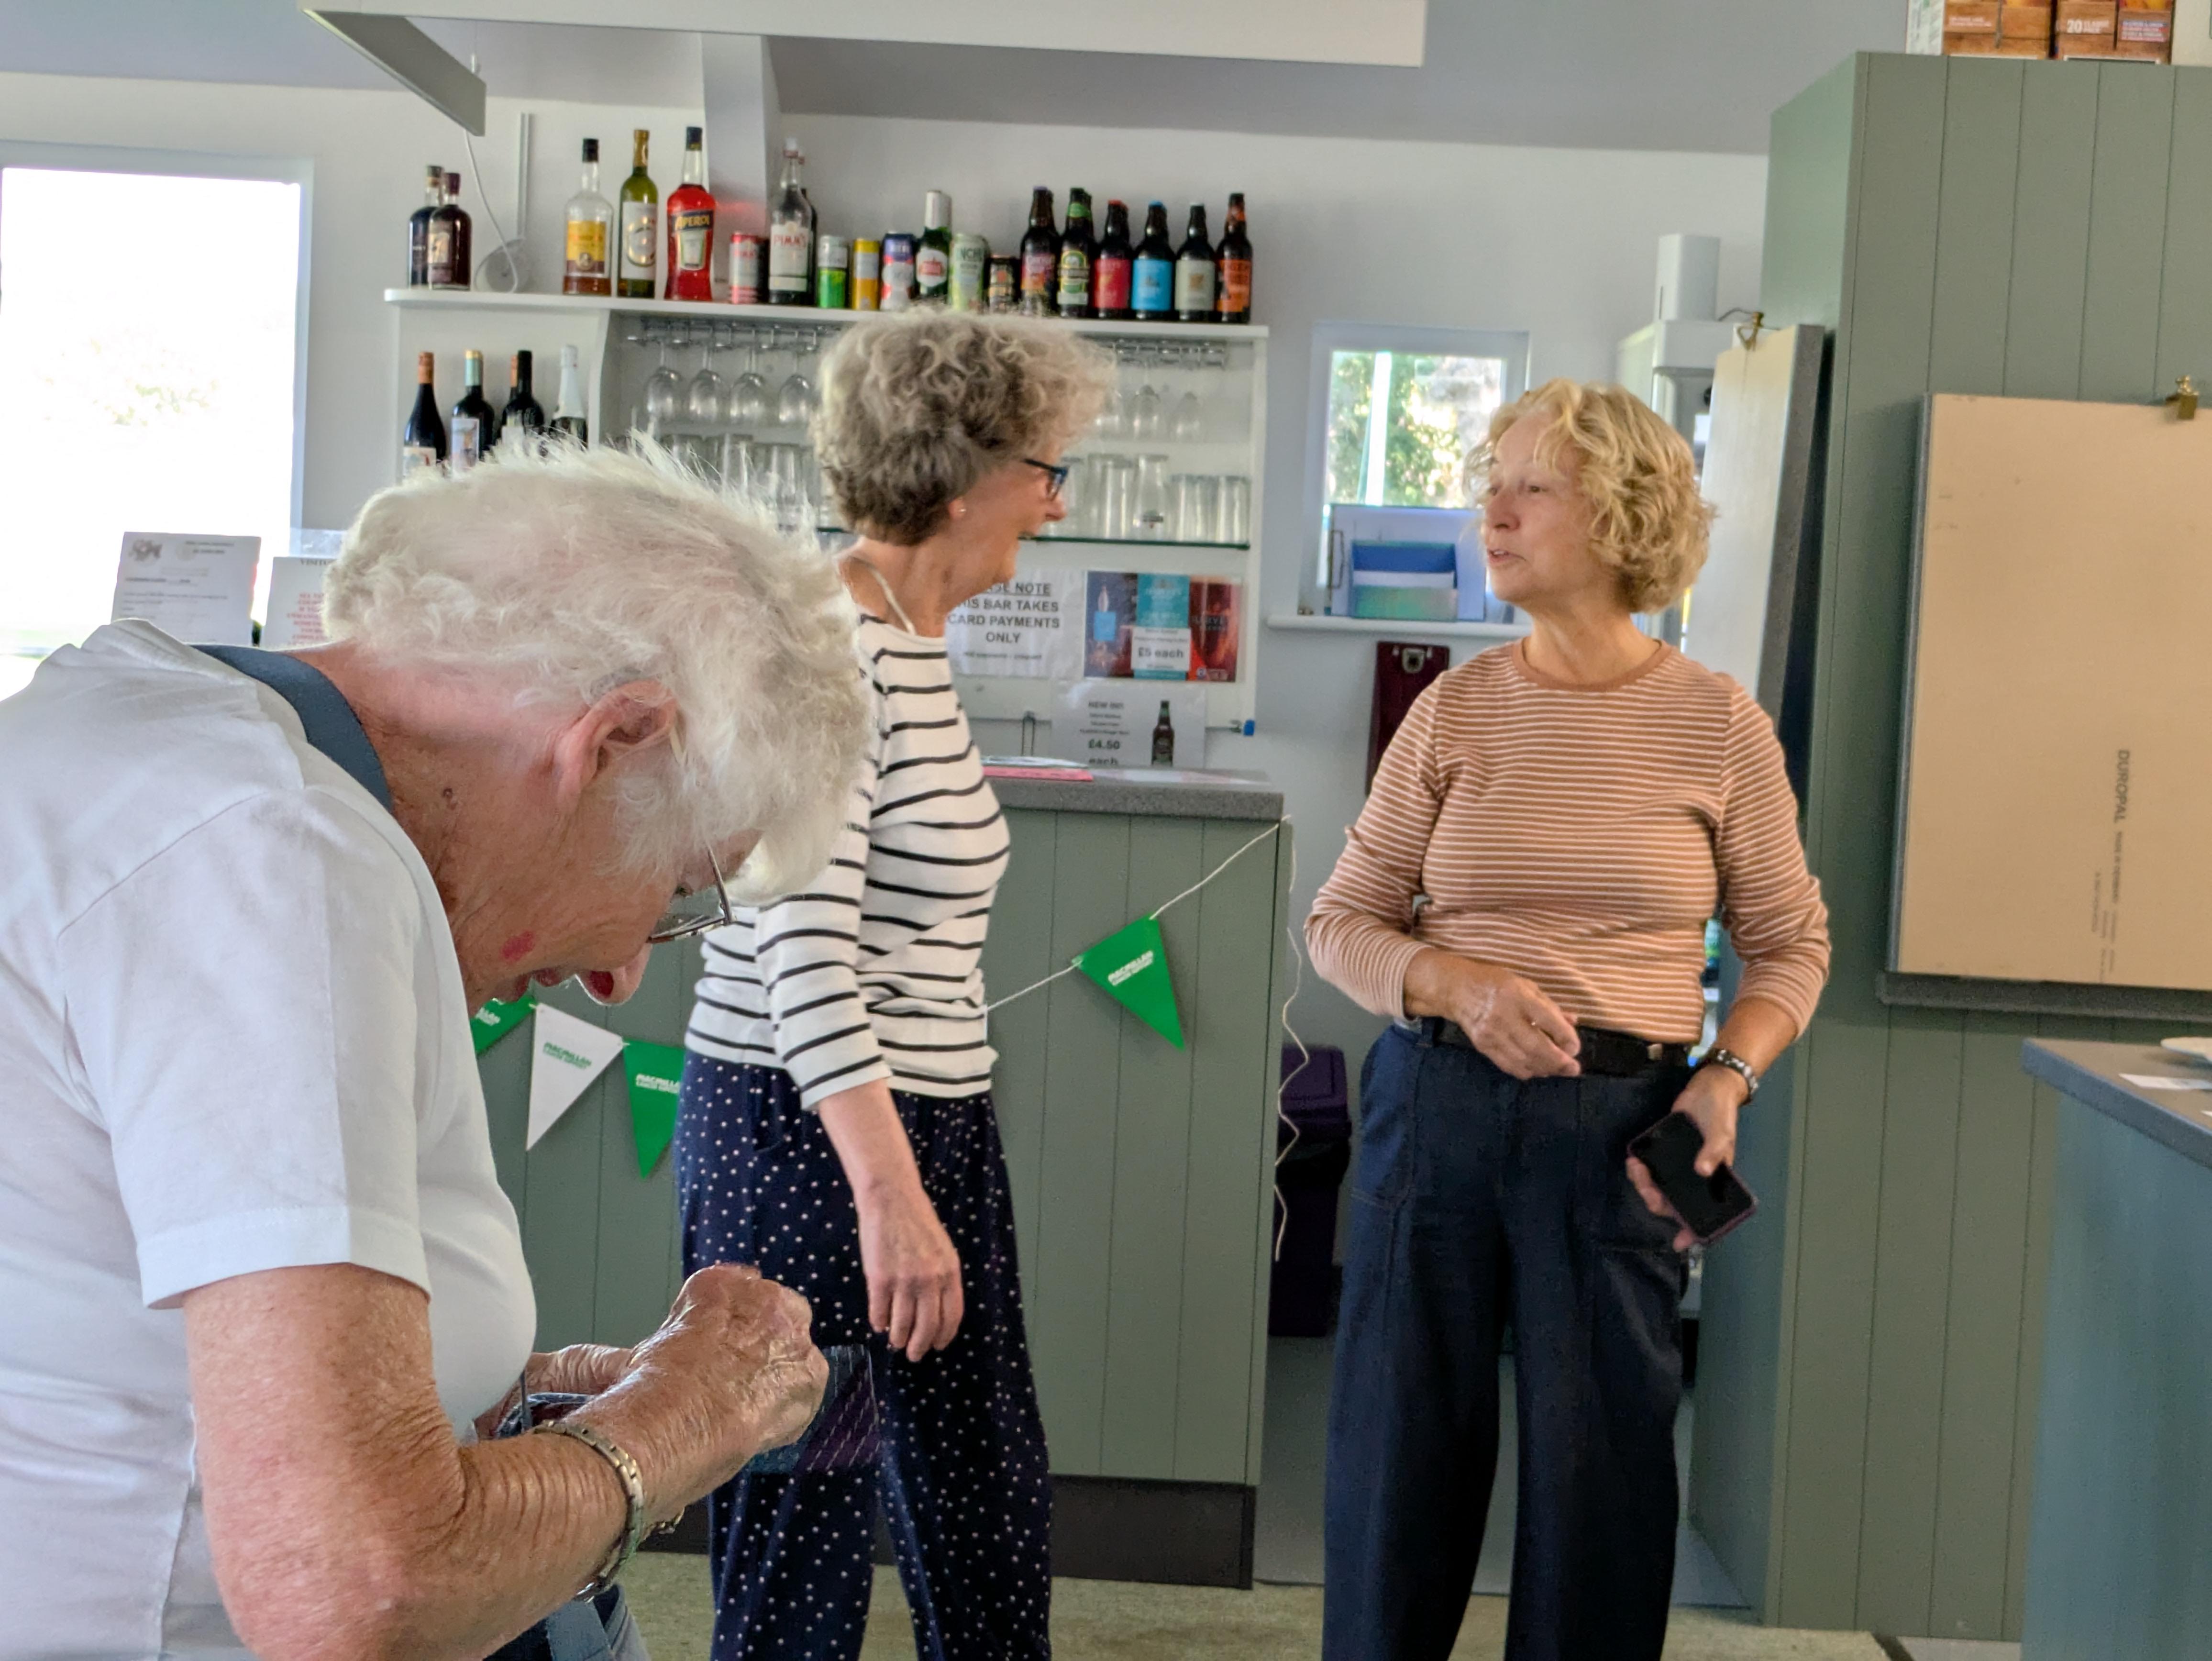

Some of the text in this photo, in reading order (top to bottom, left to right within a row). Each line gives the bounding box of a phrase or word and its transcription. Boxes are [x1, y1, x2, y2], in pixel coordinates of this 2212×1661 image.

[2067, 19, 2082, 33] 20
[674, 215, 709, 230] APEROL
[1016, 582, 1051, 593] NOTE
[984, 599, 1012, 610] BAR
[1017, 600, 1059, 612] TAKES
[948, 615, 1060, 629] CARD PAYMENTS
[986, 631, 1021, 643] ONLY
[1155, 648, 1184, 659] each
[1088, 738, 1120, 750] £4.50
[2114, 750, 2130, 824] DUROPAL
